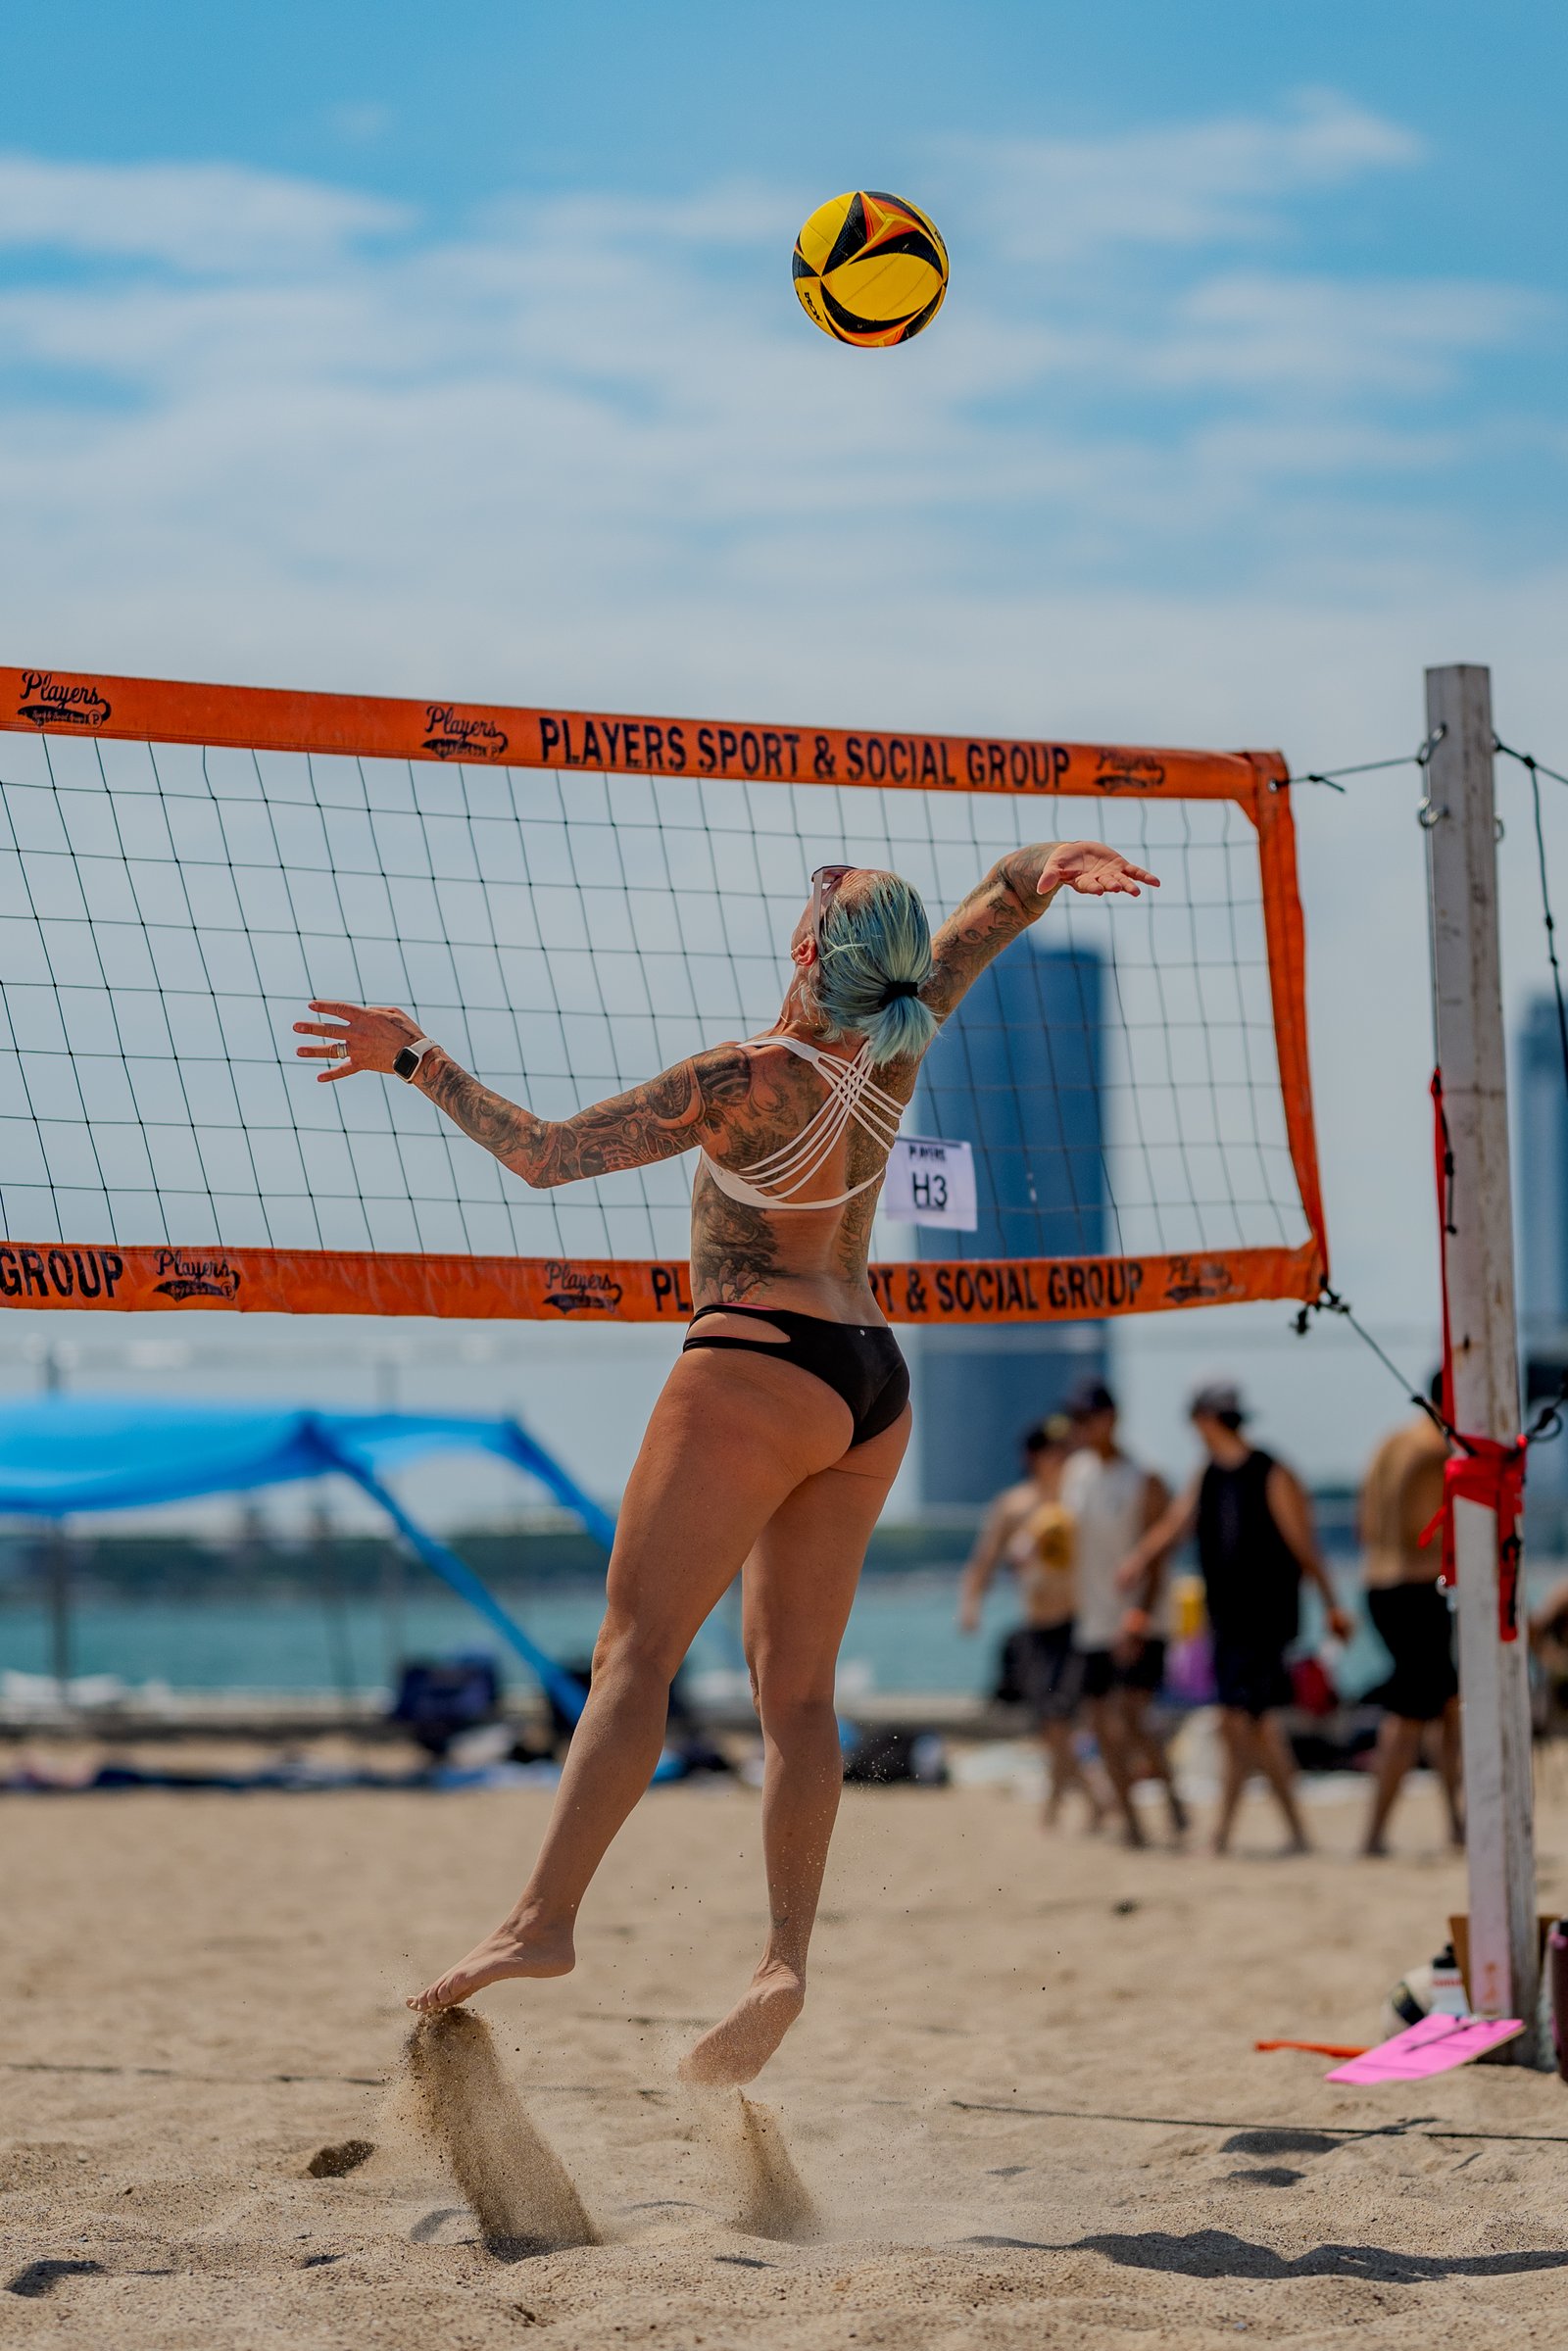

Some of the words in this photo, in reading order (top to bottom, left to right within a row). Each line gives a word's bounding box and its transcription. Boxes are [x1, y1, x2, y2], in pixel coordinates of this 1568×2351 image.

[20, 669, 102, 710] Players
[424, 706, 499, 744] Players
[539, 717, 687, 771] PLAYERS
[698, 727, 801, 777] SPORT
[813, 735, 836, 779] &
[846, 737, 956, 785] SOCIAL
[966, 743, 1070, 788] GROUP
[912, 1171, 948, 1208] H3
[0, 1248, 123, 1298] GROUP
[154, 1248, 230, 1282] Players
[545, 1260, 612, 1295] Players
[906, 1267, 928, 1312] &
[936, 1267, 1040, 1312] SOCIAL
[1048, 1262, 1144, 1310] GROUP
